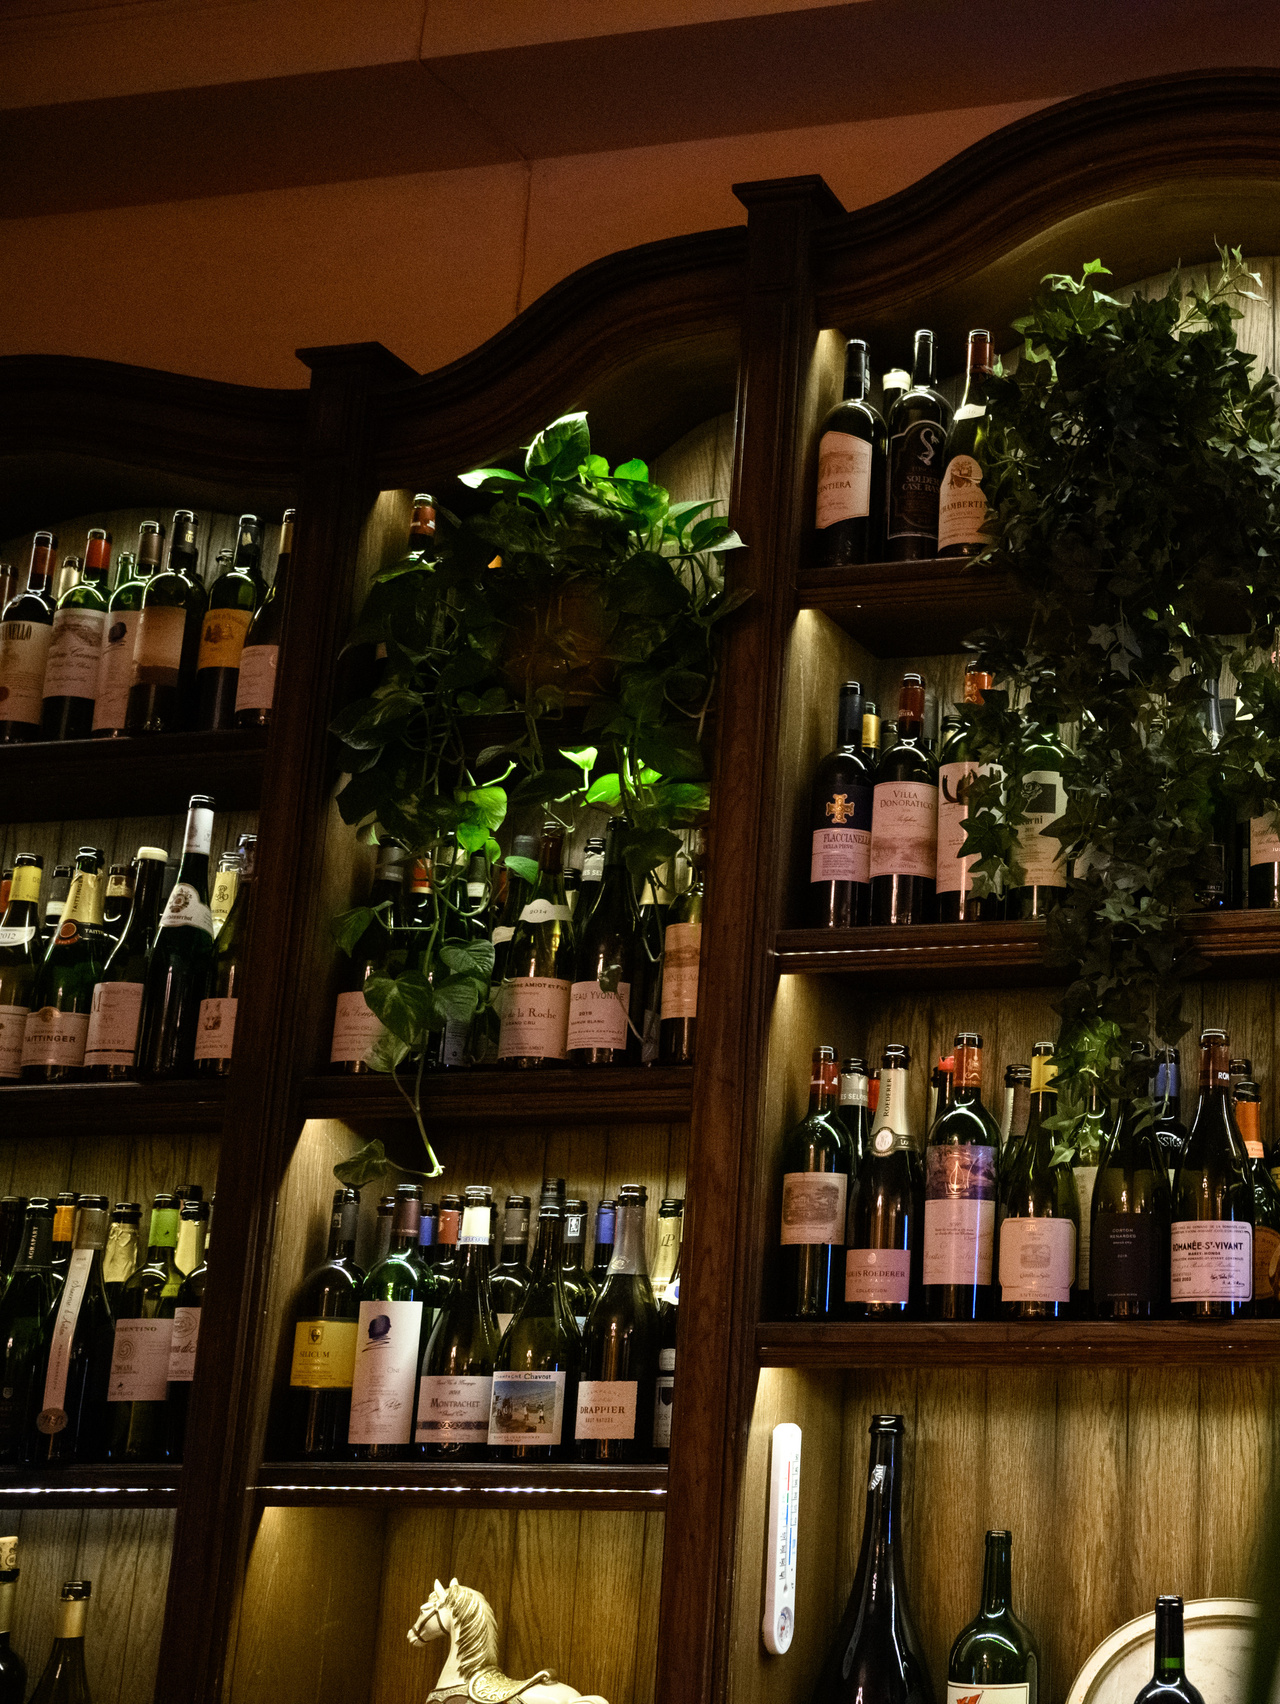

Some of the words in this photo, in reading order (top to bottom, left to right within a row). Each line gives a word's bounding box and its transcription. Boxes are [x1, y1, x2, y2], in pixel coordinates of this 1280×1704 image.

[893, 791, 918, 799] VILLA
[880, 800, 932, 809] DONORATICO
[528, 1007, 557, 1019] Roche
[883, 1077, 892, 1117] ROEDERER
[28, 1226, 38, 1259] AGRAPART
[862, 1269, 906, 1278] ROEDERER
[523, 1372, 551, 1380] Chavost
[430, 1398, 480, 1408] MONTRACHET
[579, 1406, 626, 1414] DRAPPIER
